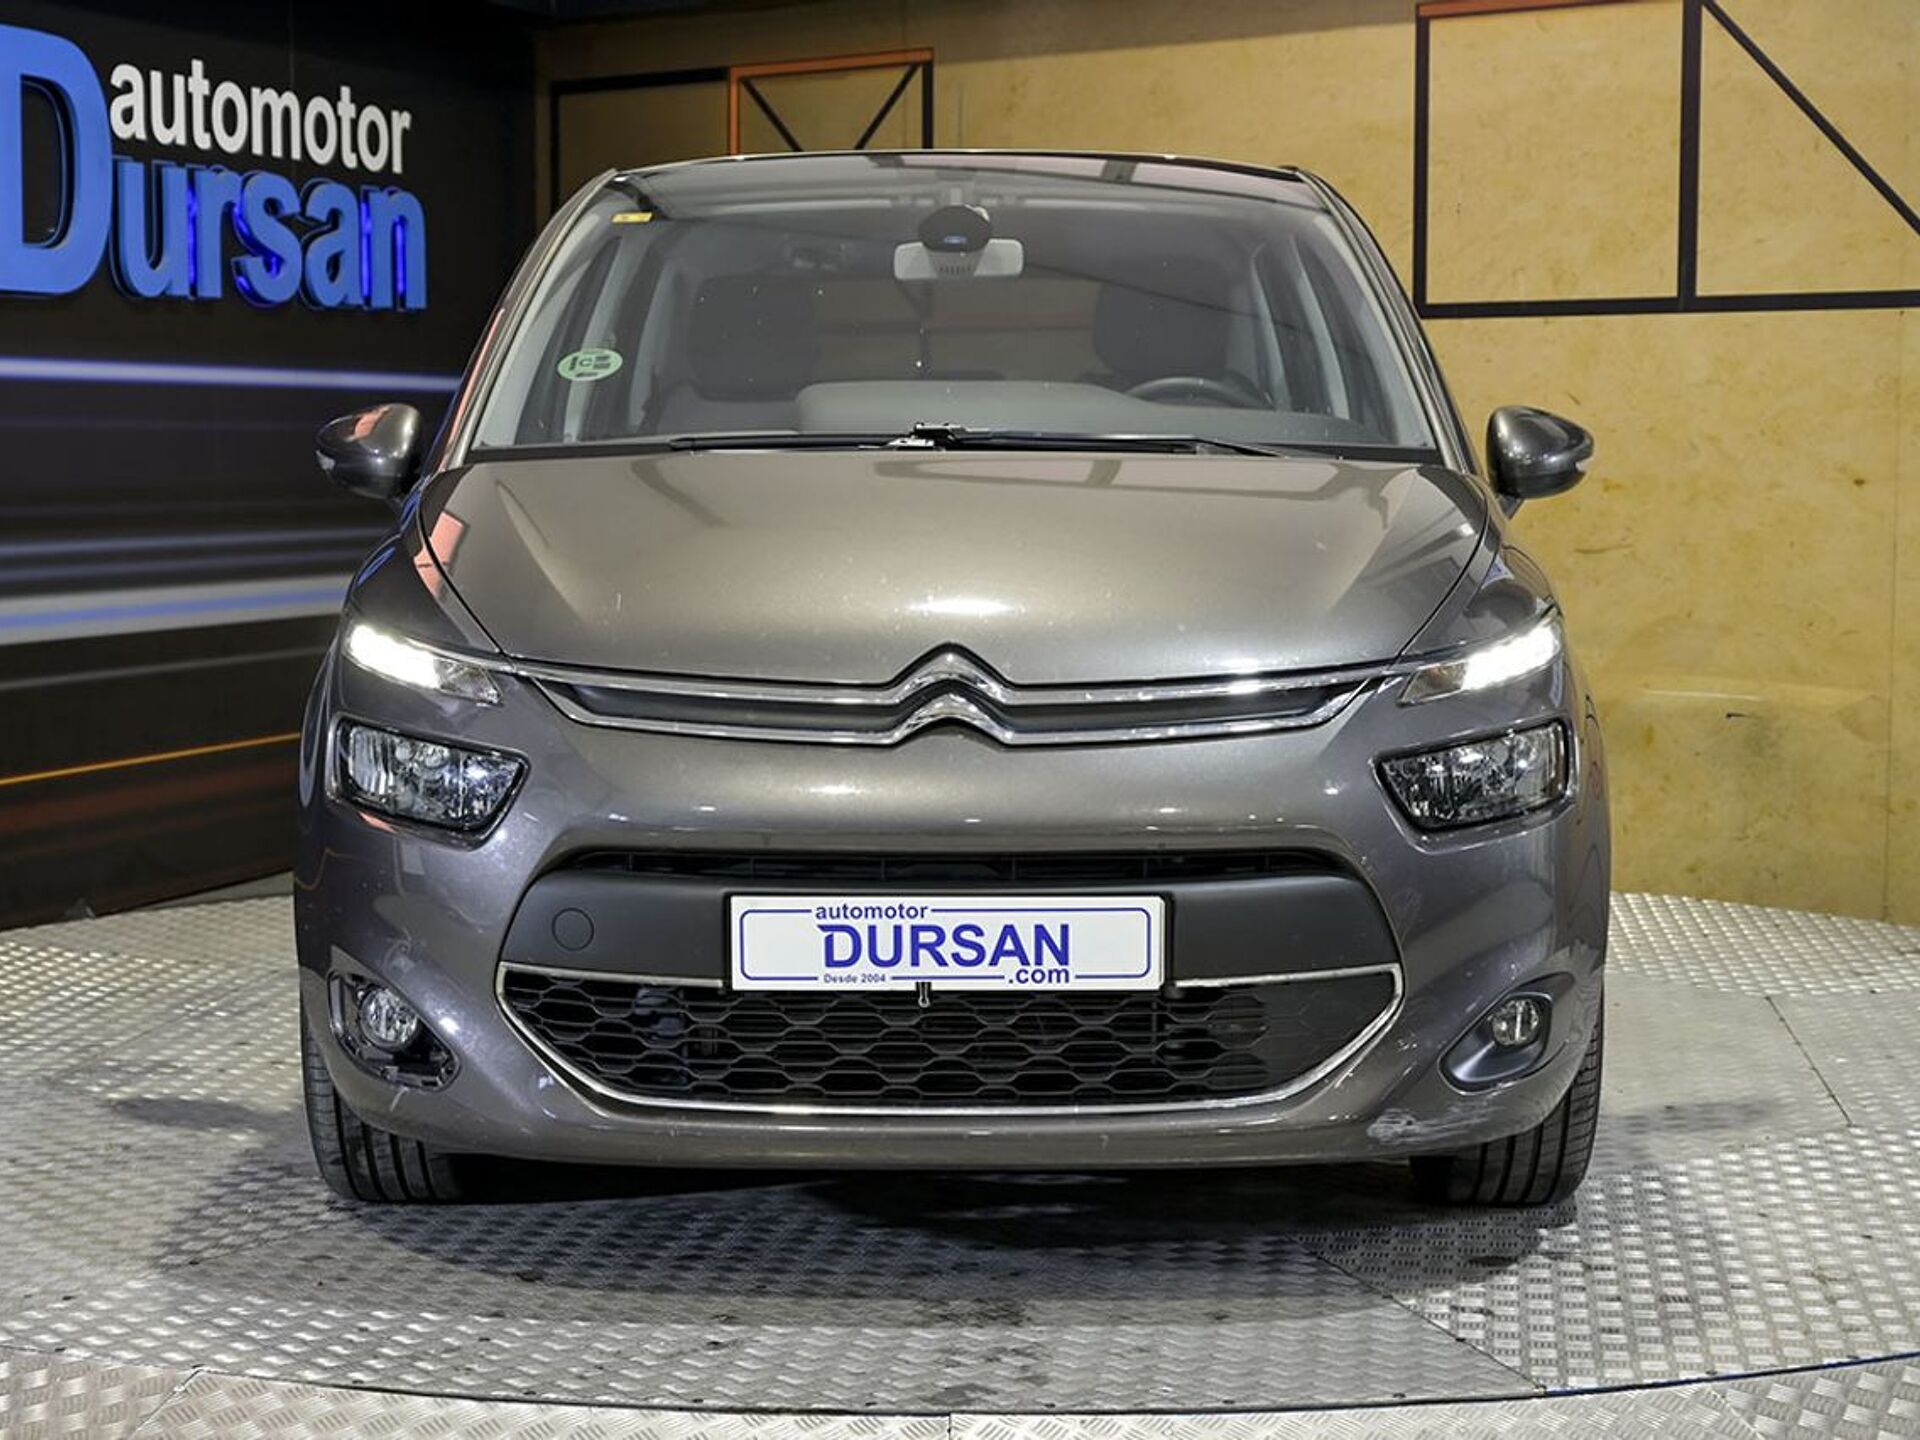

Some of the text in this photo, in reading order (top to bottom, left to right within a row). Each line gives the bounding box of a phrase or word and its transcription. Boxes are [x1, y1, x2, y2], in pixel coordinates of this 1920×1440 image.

[109, 59, 412, 174] automotor
[0, 23, 428, 311] Dursan
[815, 903, 929, 919] automotor
[816, 924, 1069, 967] DURSAN
[823, 973, 887, 983] Desde 2004
[1008, 966, 1070, 984] .com
